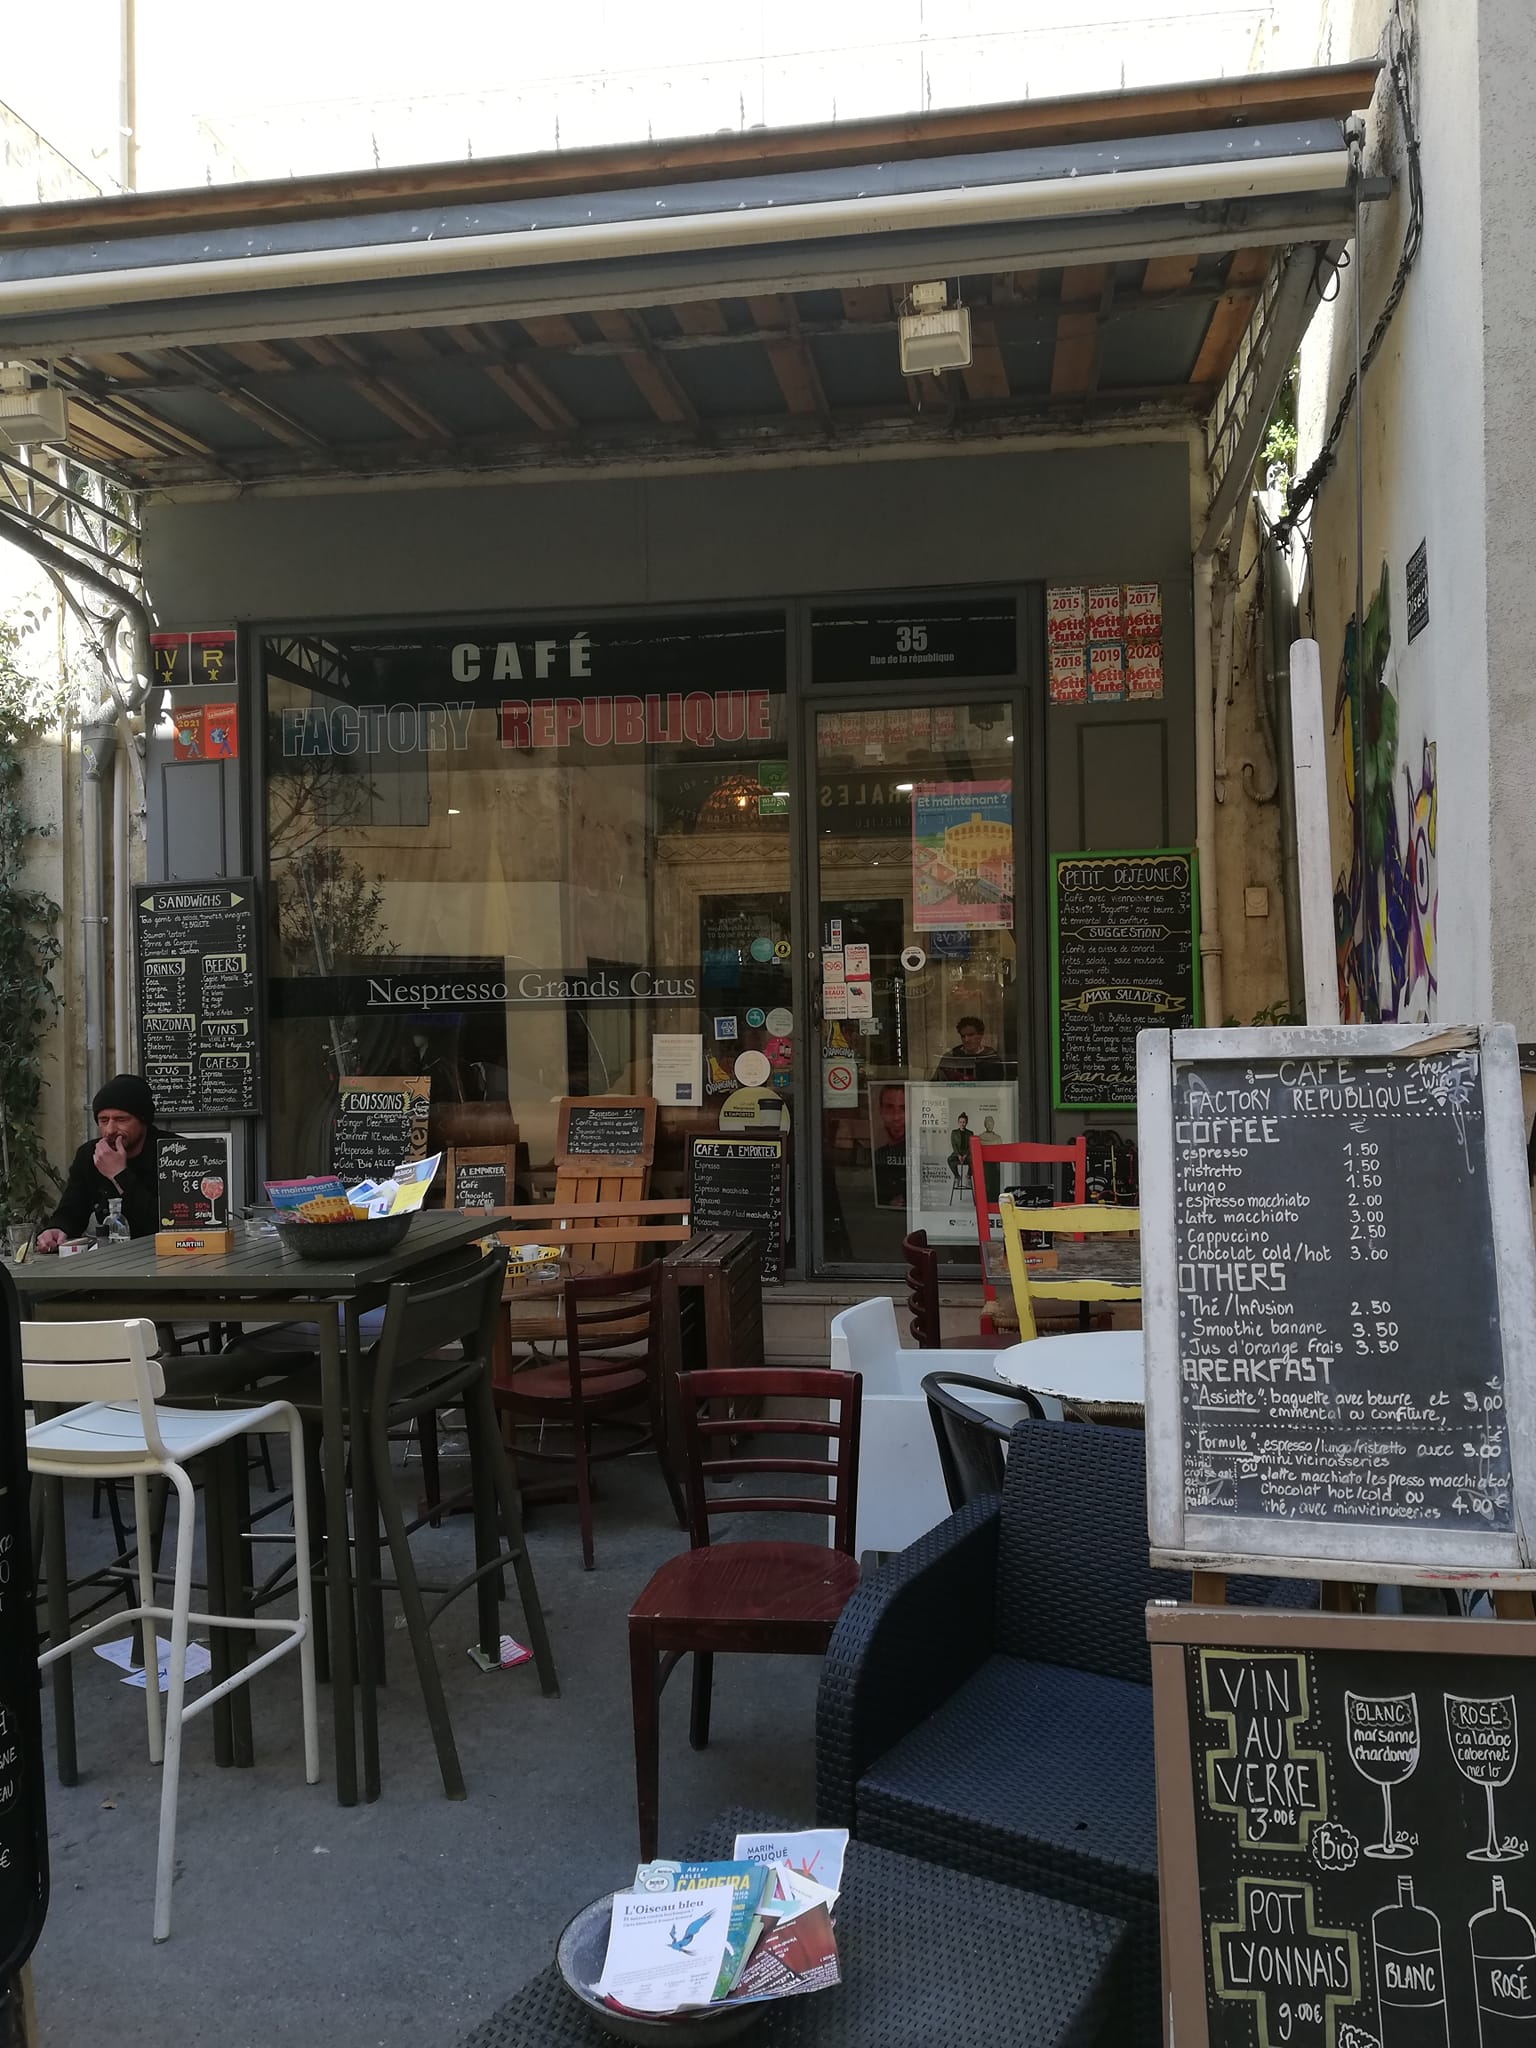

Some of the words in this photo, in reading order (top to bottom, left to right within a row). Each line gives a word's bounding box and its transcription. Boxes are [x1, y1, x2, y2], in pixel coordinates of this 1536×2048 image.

[1053, 598, 1079, 610] 2015
[1090, 597, 1118, 609] 2016
[1129, 593, 1156, 604] 2017
[896, 626, 928, 652] 35
[202, 650, 224, 668] R
[451, 632, 592, 683] CAFÉ
[870, 655, 887, 665] Rue
[887, 654, 898, 664] de
[898, 654, 908, 664] la
[908, 652, 955, 665] république
[1092, 650, 1120, 662] 2019
[1128, 645, 1160, 659] 2020
[1054, 656, 1081, 668] 2018
[283, 701, 475, 757] FACTORY
[497, 689, 771, 749] REPUBLIQUE
[917, 797, 930, 808] Et
[932, 795, 1000, 807] maintenant
[1114, 866, 1183, 884] DÉJEUNER
[205, 958, 239, 973] BEERS
[366, 978, 509, 1009] Nespresso
[519, 972, 620, 998] Grands
[630, 971, 696, 997] Crus
[1115, 989, 1162, 1003] SALADES
[146, 1017, 191, 1032] ARIZONA
[155, 1065, 180, 1075] JUS
[206, 1056, 239, 1069] CAFES
[1418, 1058, 1447, 1077] Free
[350, 1093, 402, 1111] BOISSONS
[1188, 1087, 1271, 1115] FACTORY
[1175, 1119, 1280, 1144] COFFEE
[726, 1145, 734, 1157] A
[738, 1145, 776, 1157] EMPORTER
[1182, 1147, 1249, 1166] espresso
[1342, 1143, 1379, 1157] 1.50
[460, 1168, 467, 1177] A
[468, 1166, 505, 1175] EMPORTER
[1183, 1163, 1243, 1178] ristretto
[1343, 1159, 1381, 1174] 1.50
[182, 1180, 190, 1194] 8
[191, 1179, 199, 1190] €
[283, 1182, 332, 1194] maintenant
[460, 1180, 479, 1189] Café
[1183, 1179, 1227, 1197] lungo
[1345, 1174, 1383, 1189] 1.50
[1186, 1195, 1245, 1215] espresso
[1247, 1192, 1311, 1208] macchiato
[1347, 1194, 1384, 1207] 2.00
[1185, 1209, 1217, 1225] latte
[1223, 1209, 1300, 1224] macchiato
[1350, 1210, 1385, 1223] 3.00
[1187, 1227, 1270, 1249] Cappuccino
[1350, 1224, 1387, 1241] 2.50
[1188, 1244, 1256, 1261] Chocolat
[1350, 1245, 1389, 1261] 3.00
[1178, 1263, 1287, 1293] OTHERS
[1350, 1300, 1392, 1316] 2.50
[1192, 1317, 1264, 1338] Smoothie
[1271, 1319, 1327, 1336] banane
[1351, 1321, 1400, 1338] 3.50
[1189, 1337, 1222, 1357] Jus
[1228, 1337, 1298, 1364] d'orange
[1355, 1339, 1400, 1356] 3.50
[1182, 1357, 1335, 1385] BREAKFAST
[1270, 1387, 1329, 1409] baguette
[1335, 1394, 1364, 1406] avec
[1366, 1389, 1413, 1406] beurre
[1429, 1391, 1451, 1406] et
[1463, 1391, 1503, 1413] 3.00
[1269, 1407, 1342, 1421] emmental
[1349, 1410, 1365, 1421] ou
[1261, 1453, 1294, 1466] mini
[1416, 1444, 1454, 1458] avec
[1462, 1442, 1502, 1459] 3.00
[1267, 1466, 1297, 1481] latte
[1300, 1469, 1362, 1484] macchiato
[1300, 1502, 1328, 1516] avec
[1355, 1702, 1406, 1723] BLANC
[1459, 1702, 1503, 1725] ROSÉ
[1244, 1716, 1282, 1760] AU
[1455, 1730, 1512, 1747] caladoc
[1457, 1747, 1510, 1761] cabernet
[1216, 1762, 1316, 1808] VERRE
[1249, 1807, 1297, 1842] 3.00€
[747, 1843, 775, 1855] MARIN
[1320, 1831, 1353, 1861] Bio
[624, 1901, 677, 1917] L'Oiseau
[678, 1898, 705, 1910] bleu
[1249, 1888, 1303, 1935] POT
[1385, 1961, 1436, 1992] BLANC
[1490, 1963, 1532, 2001] ROSÉ
[1278, 2002, 1323, 2041] 9.00€
